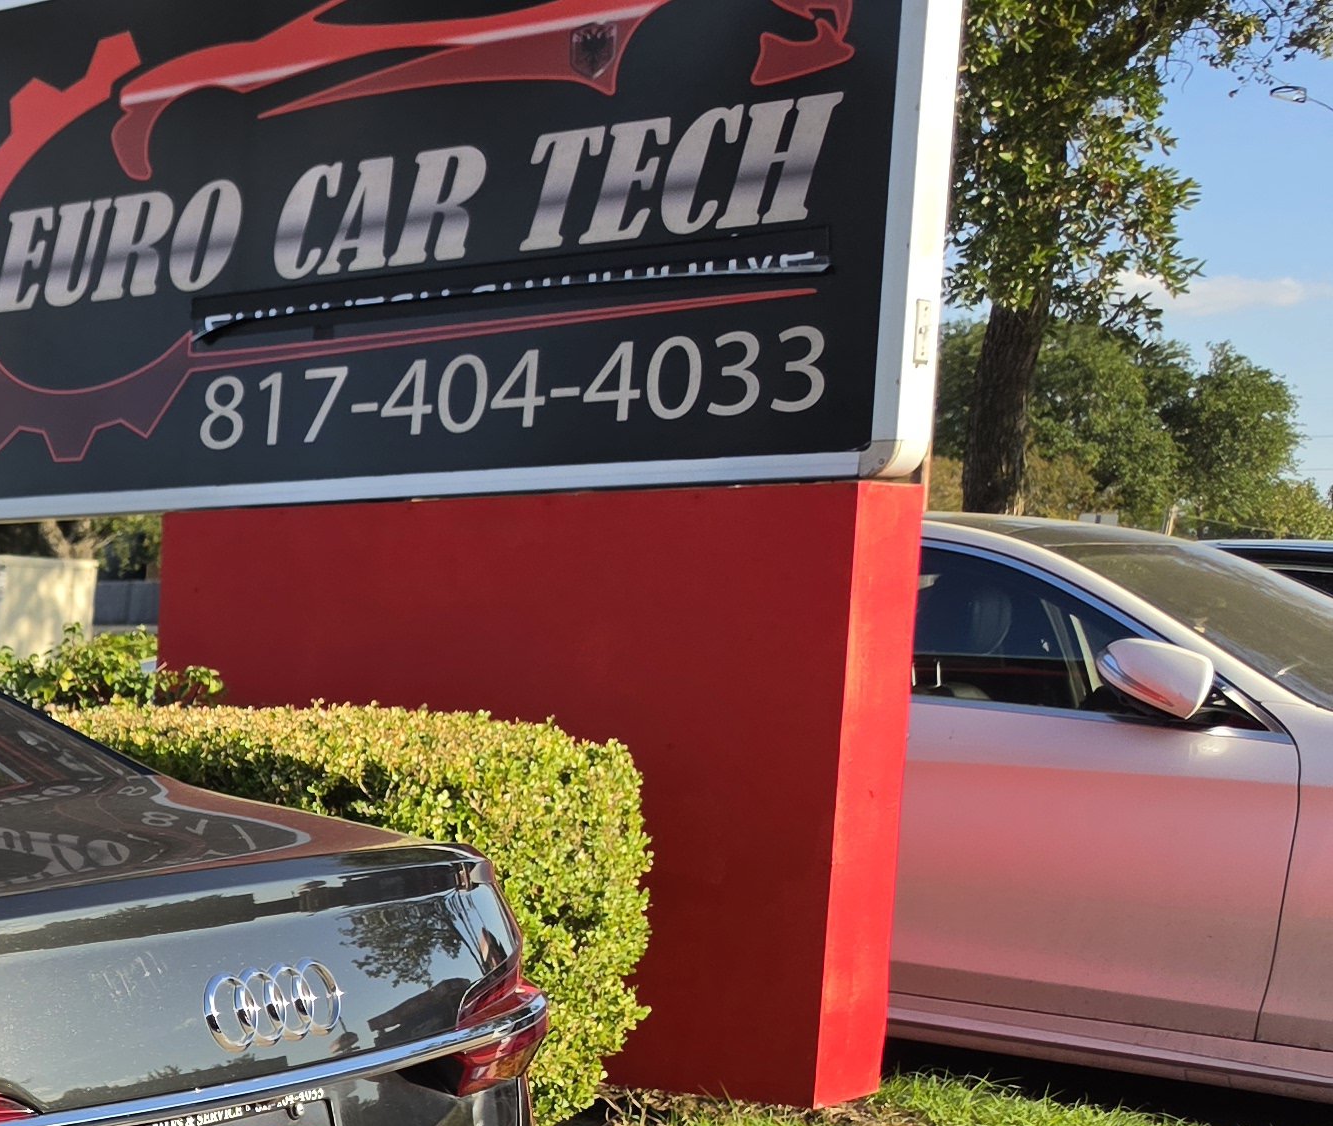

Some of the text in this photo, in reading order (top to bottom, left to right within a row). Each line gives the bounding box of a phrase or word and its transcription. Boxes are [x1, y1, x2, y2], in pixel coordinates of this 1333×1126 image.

[272, 144, 488, 283] CAR
[518, 91, 845, 254] TECH
[197, 325, 827, 451] 817-404-4033
